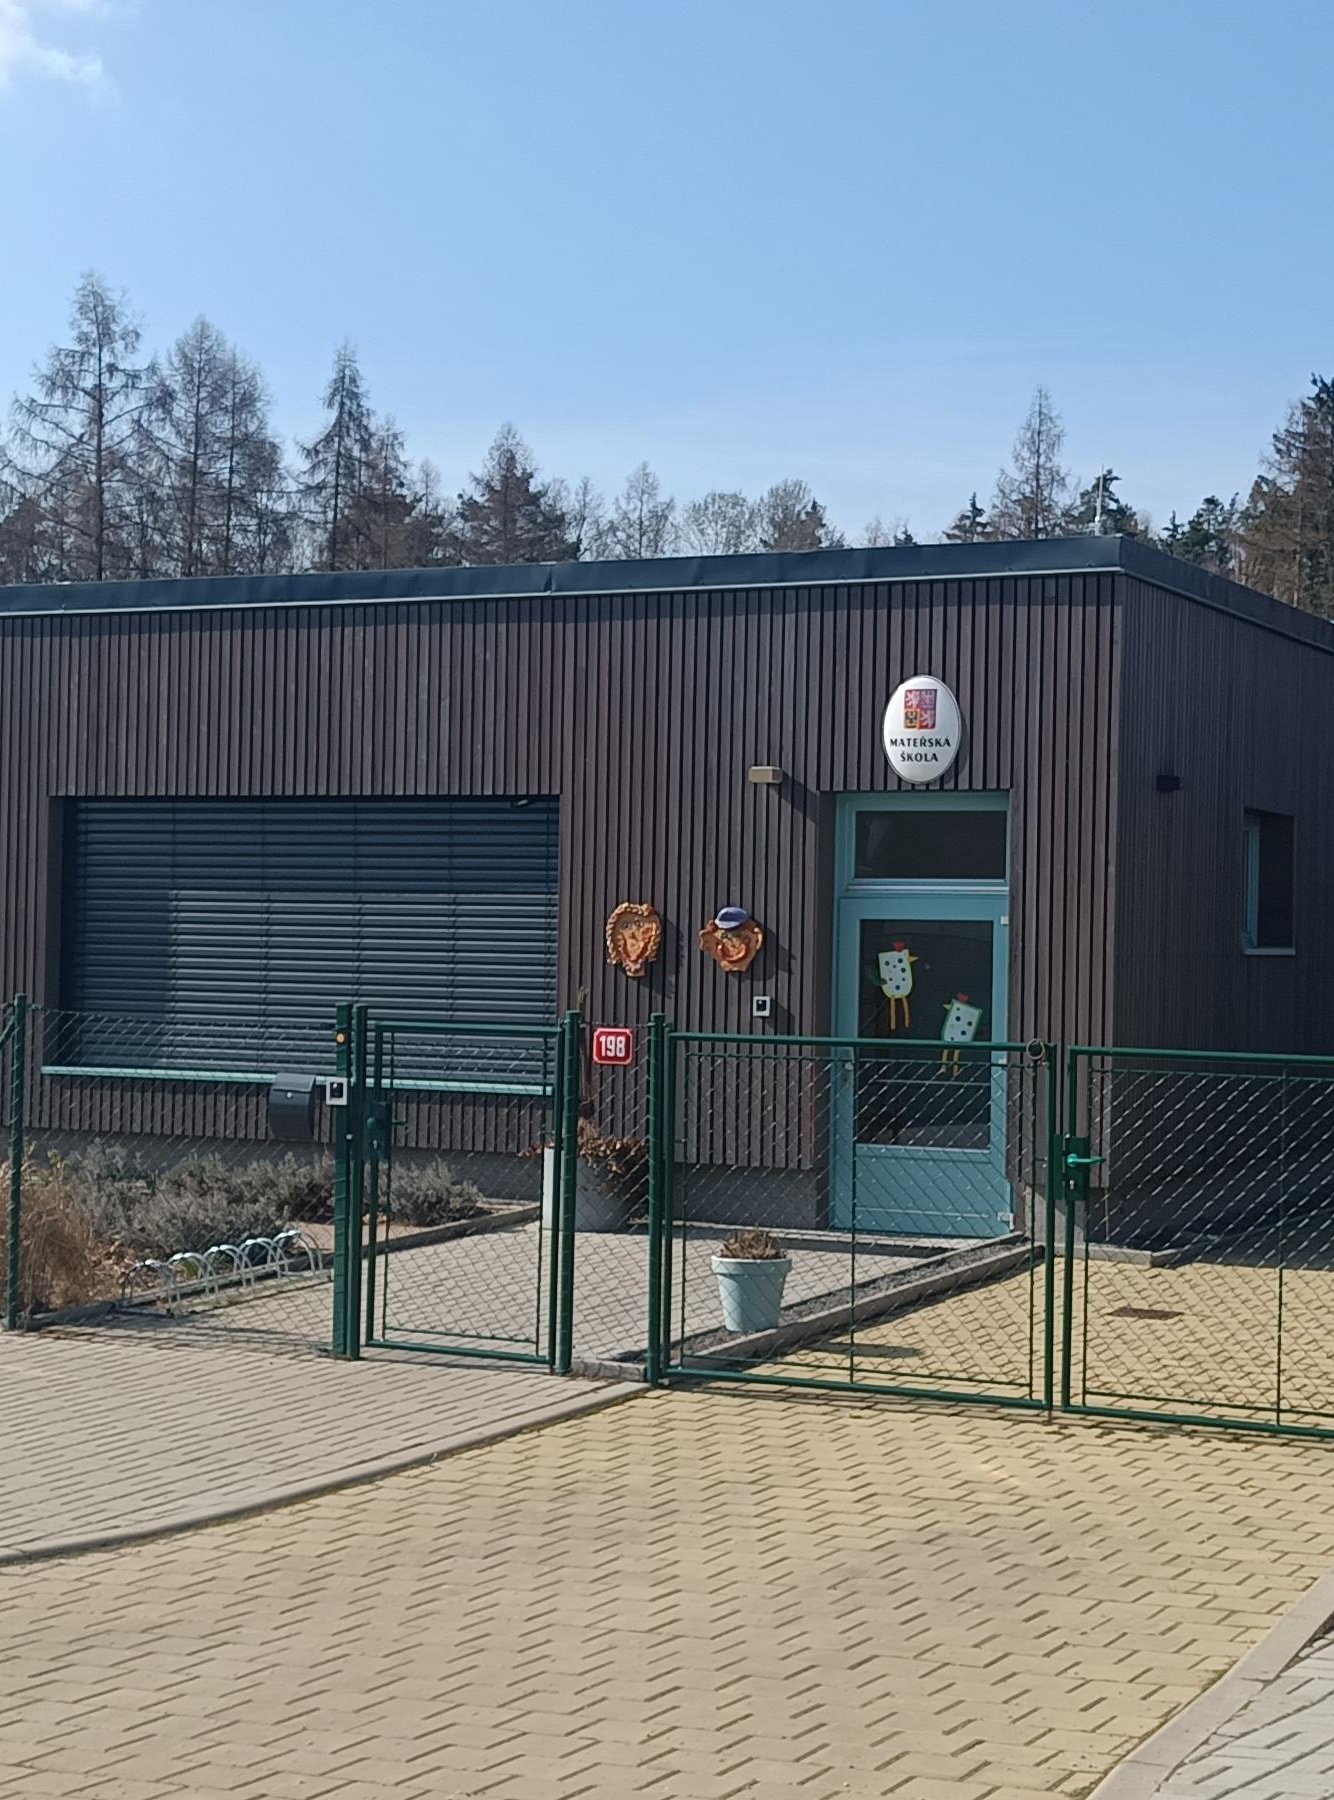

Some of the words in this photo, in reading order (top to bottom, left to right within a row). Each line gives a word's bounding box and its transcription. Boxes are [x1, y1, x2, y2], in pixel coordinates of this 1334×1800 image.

[890, 736, 951, 748] MATEŘSKÁ
[900, 751, 938, 762] ŠKOLA
[599, 1035, 626, 1057] 198
